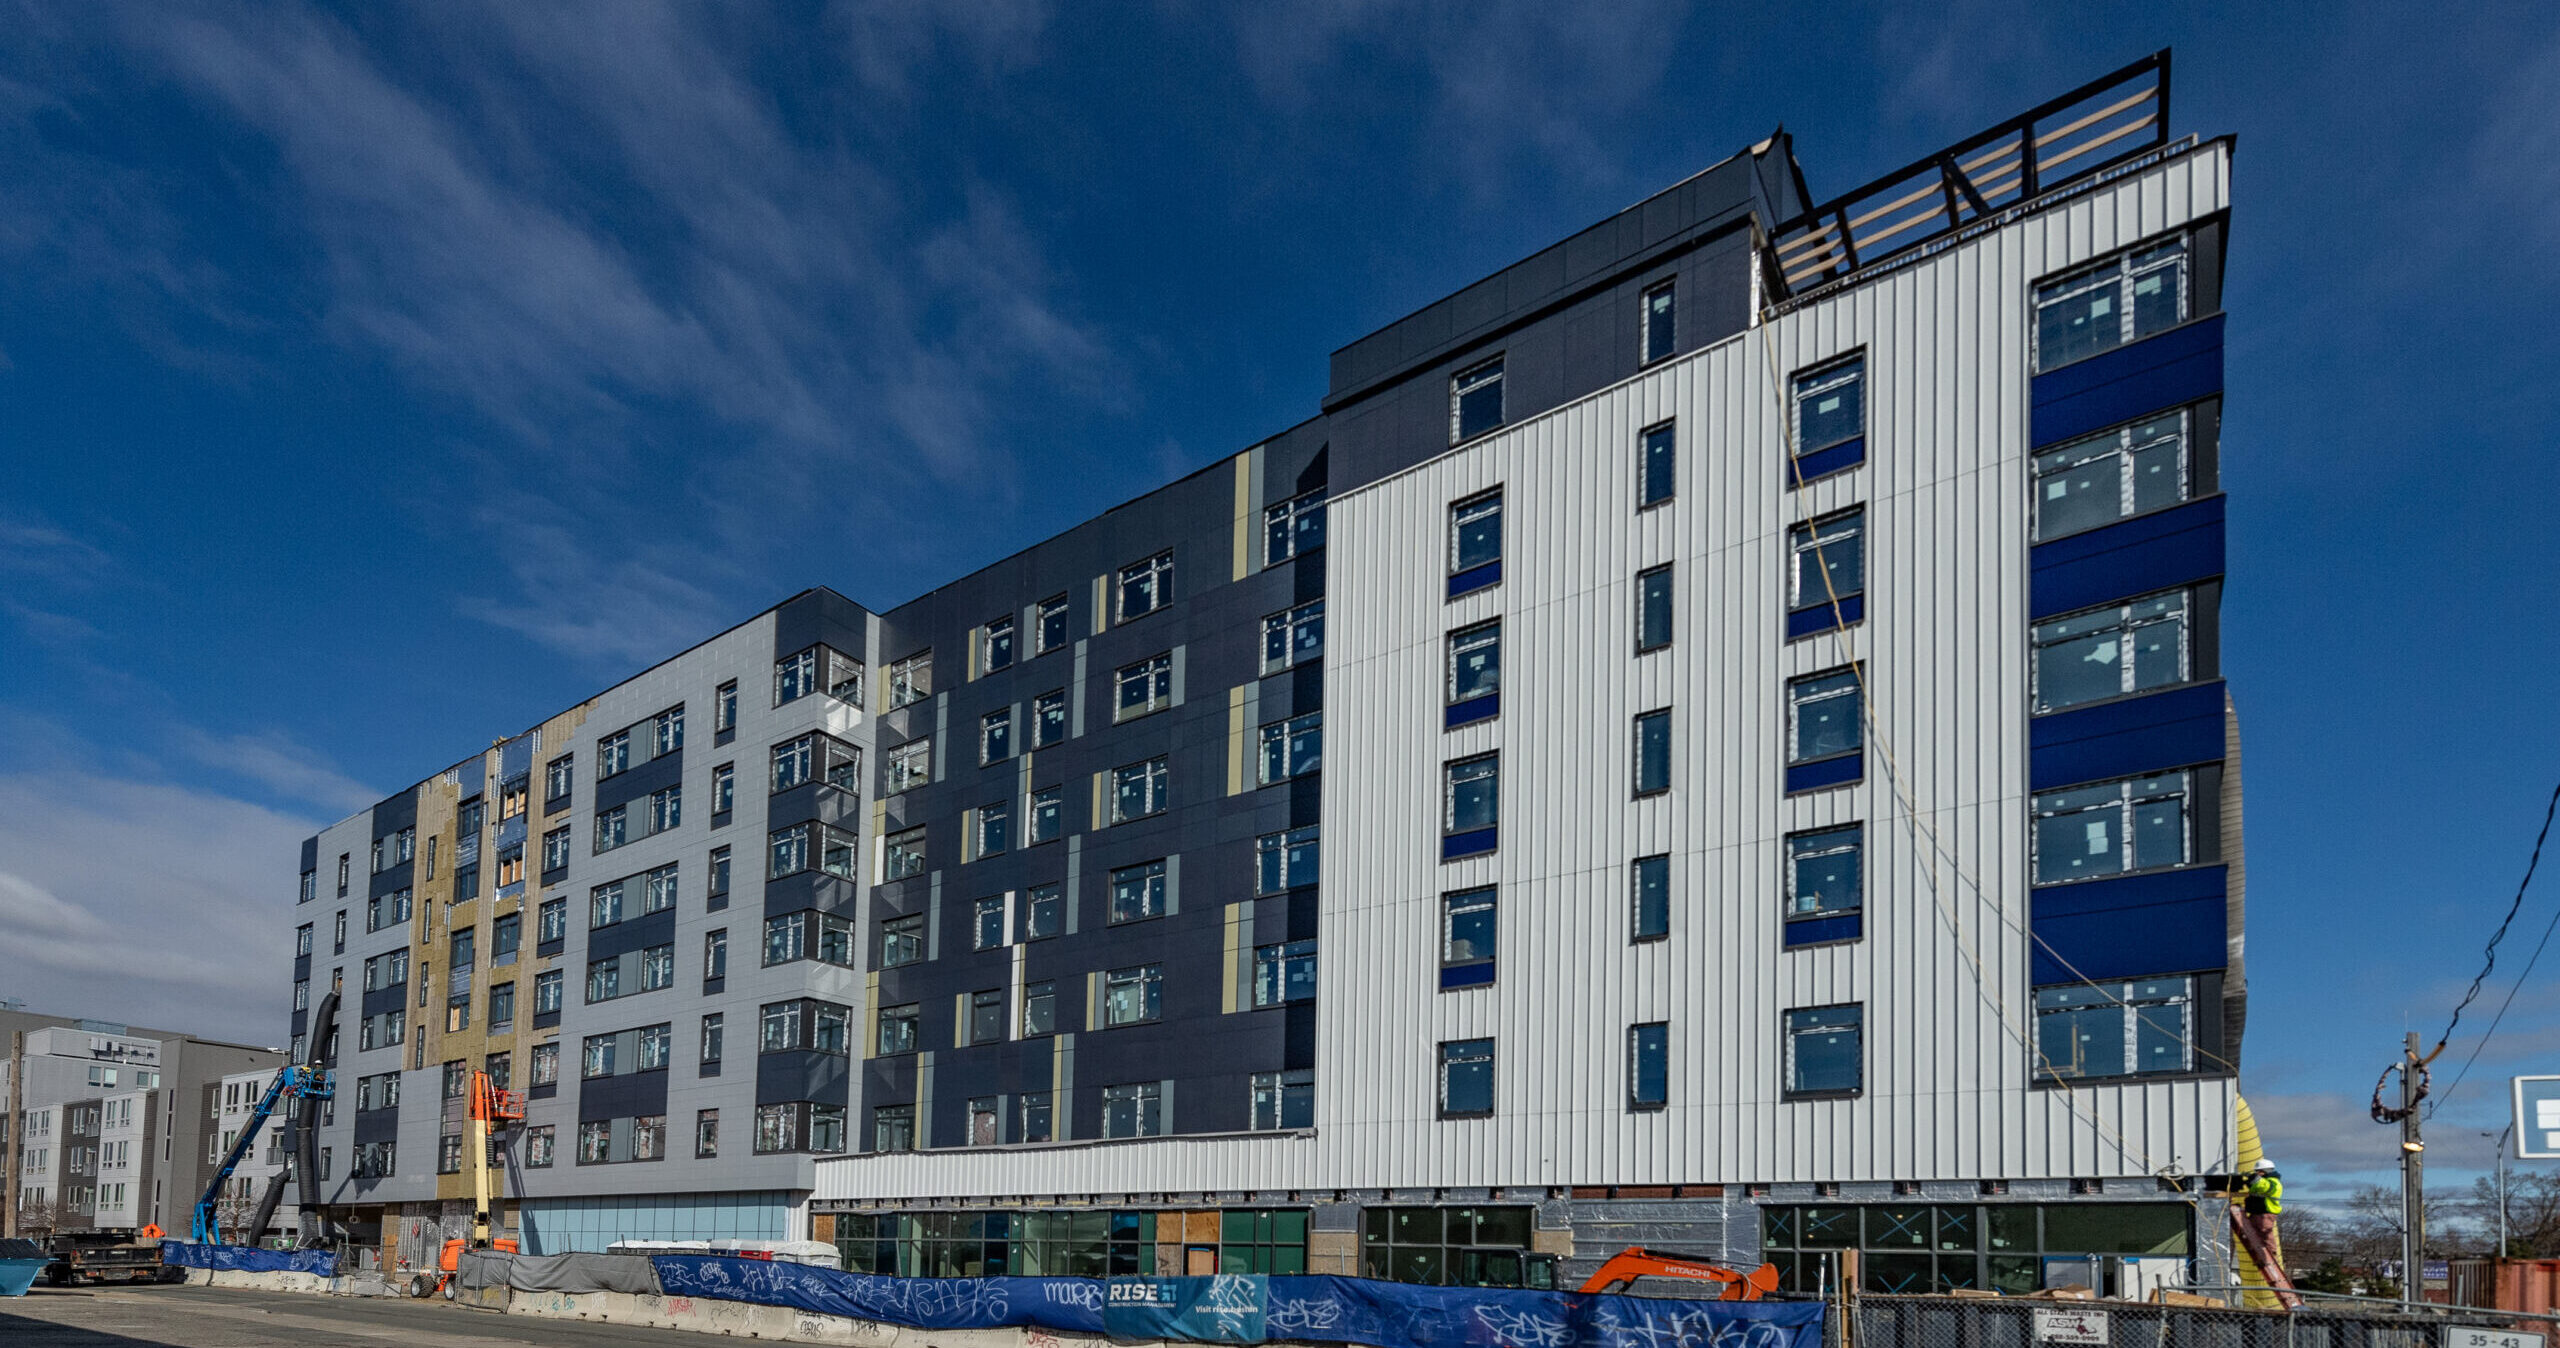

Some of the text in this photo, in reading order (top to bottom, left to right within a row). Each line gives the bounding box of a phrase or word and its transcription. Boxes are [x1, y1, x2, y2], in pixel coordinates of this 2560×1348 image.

[1665, 1265, 1710, 1277] HITACHI
[1109, 1284, 1158, 1301] RISE
[2046, 1318, 2081, 1328] ASW
[2469, 1334, 2488, 1347] 35
[2501, 1338, 2520, 1348] 43
